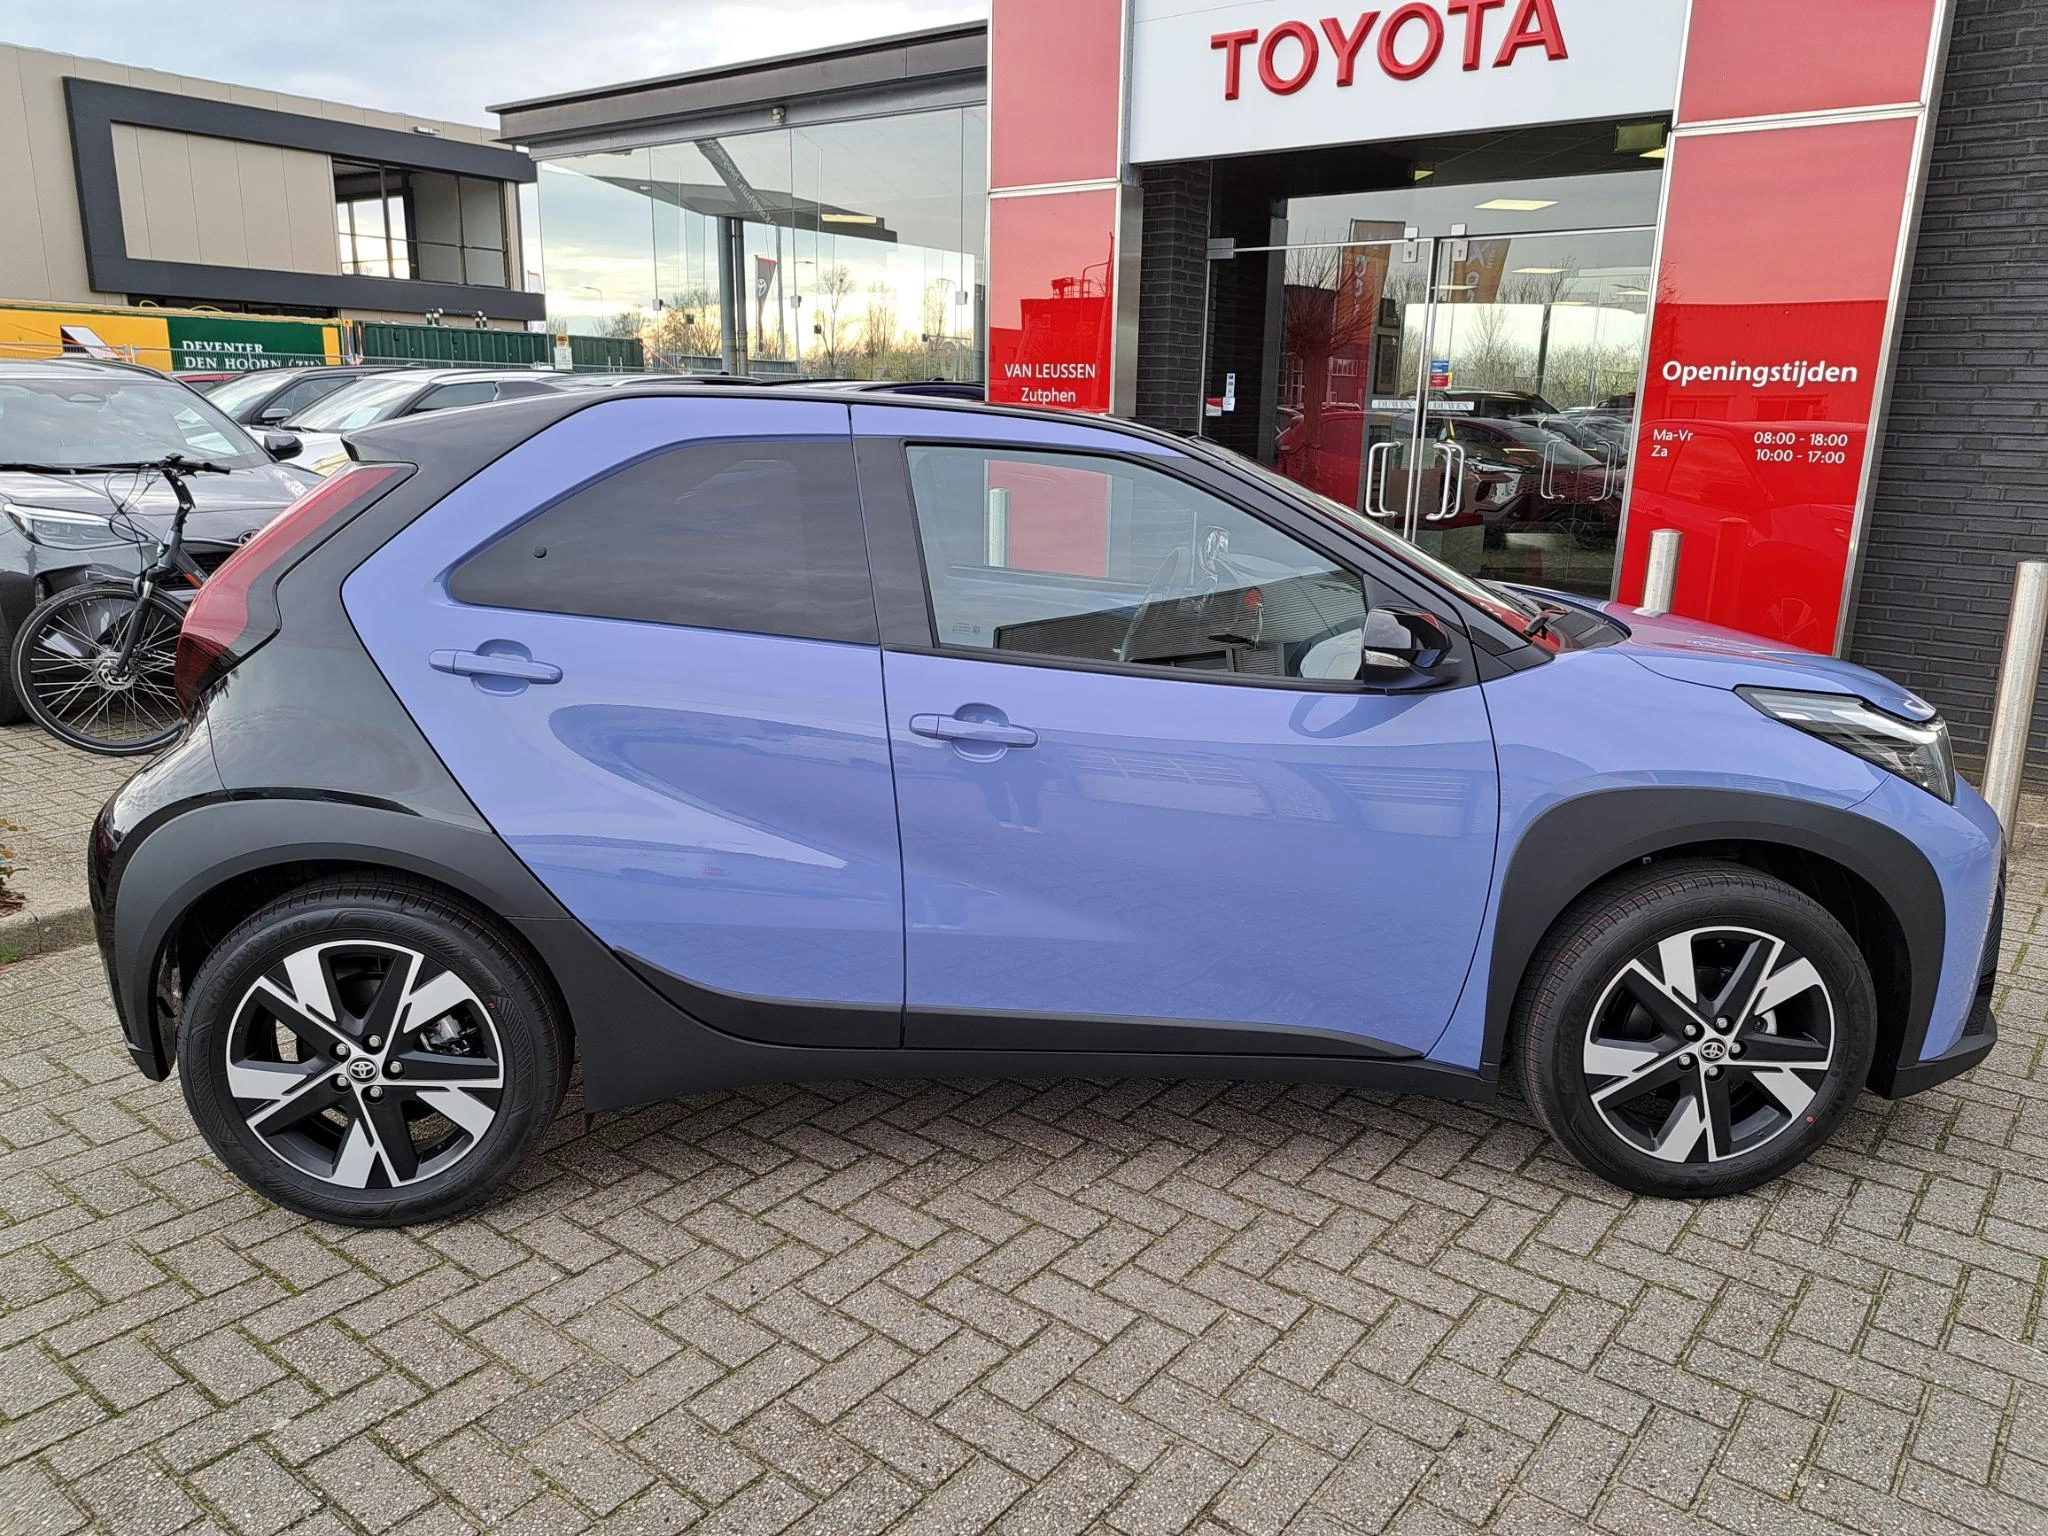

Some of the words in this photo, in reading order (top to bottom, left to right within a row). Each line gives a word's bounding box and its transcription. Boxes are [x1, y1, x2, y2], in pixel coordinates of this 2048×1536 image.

[1210, 0, 1568, 101] TOYOTA
[182, 340, 264, 354] DEVENTER
[184, 356, 217, 369] DEN
[225, 358, 282, 370] HOORN
[1004, 363, 1032, 378] VAN
[1036, 363, 1096, 379] LEUSSEN
[1662, 360, 1858, 388] Openingstijden
[1021, 387, 1076, 405] Zutphen
[1653, 429, 1694, 441] Ma-Vr
[1754, 431, 1796, 445] 08:00
[1810, 433, 1848, 447] 18:00
[1651, 445, 1668, 458] Za
[1756, 449, 1793, 462] 10:00
[1807, 451, 1845, 464] 17:00
